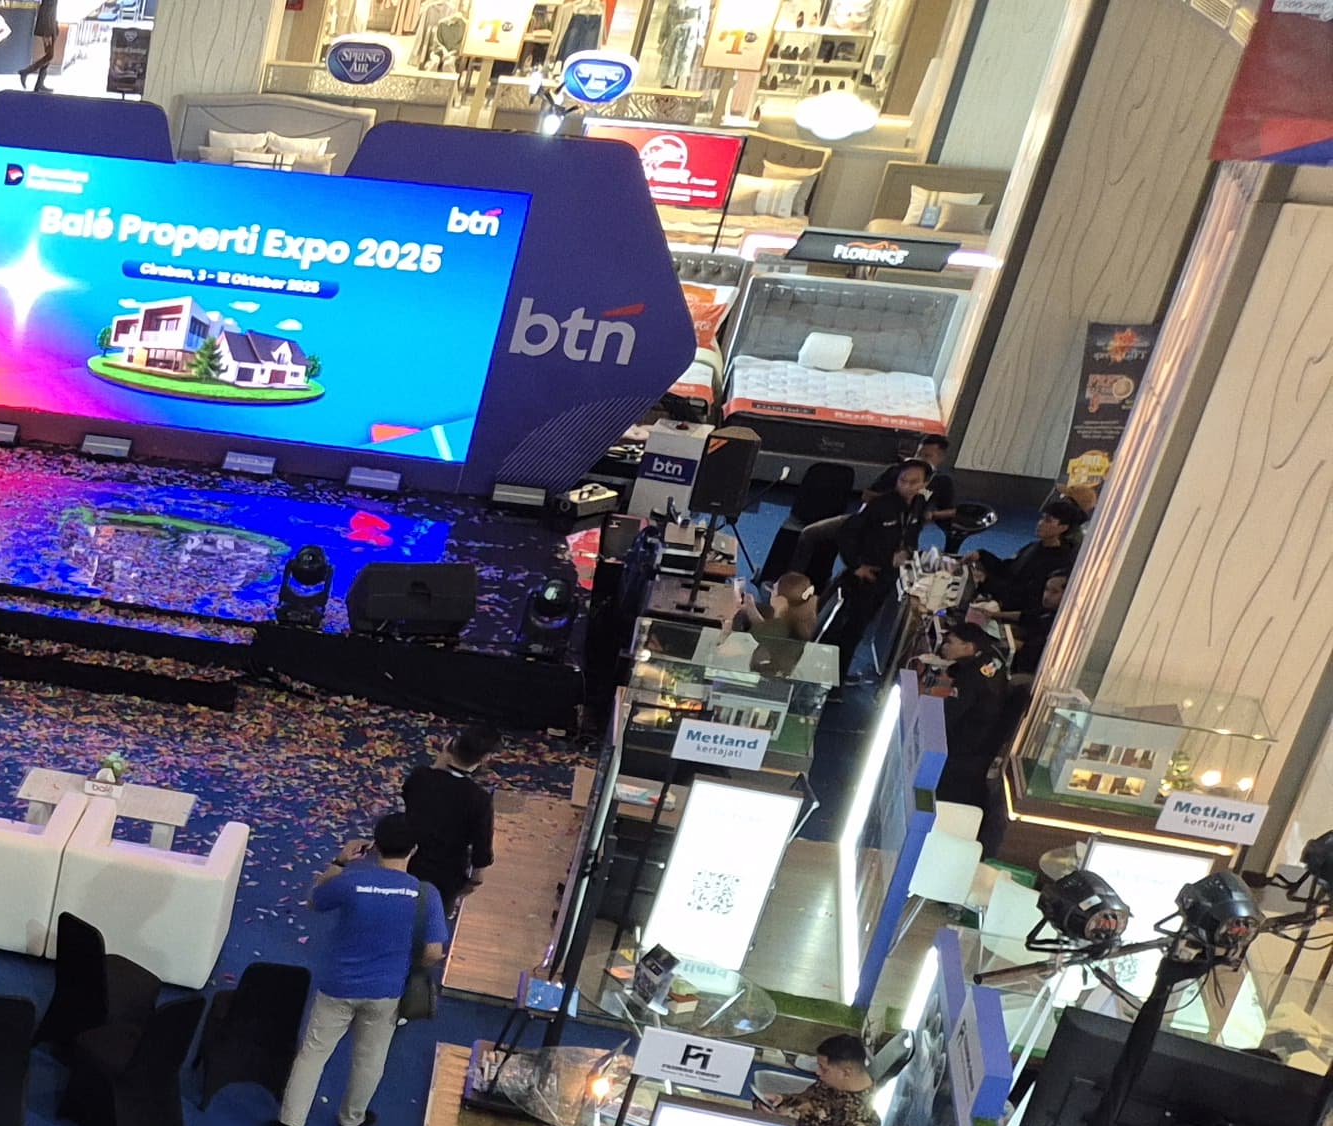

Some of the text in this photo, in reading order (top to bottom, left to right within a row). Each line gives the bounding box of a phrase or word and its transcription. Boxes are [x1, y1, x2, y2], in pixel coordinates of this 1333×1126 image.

[340, 50, 382, 65] SPRING
[349, 61, 370, 74] AIR
[447, 207, 503, 237] btn
[39, 205, 442, 274] Balé Properti Expo 2025
[833, 244, 909, 265] FLORENCE
[508, 297, 644, 366] btn
[652, 457, 683, 476] btn
[686, 729, 759, 750] Metland
[696, 744, 743, 759] kertajati
[1173, 800, 1256, 824] Metland
[1183, 815, 1235, 832] kertajati
